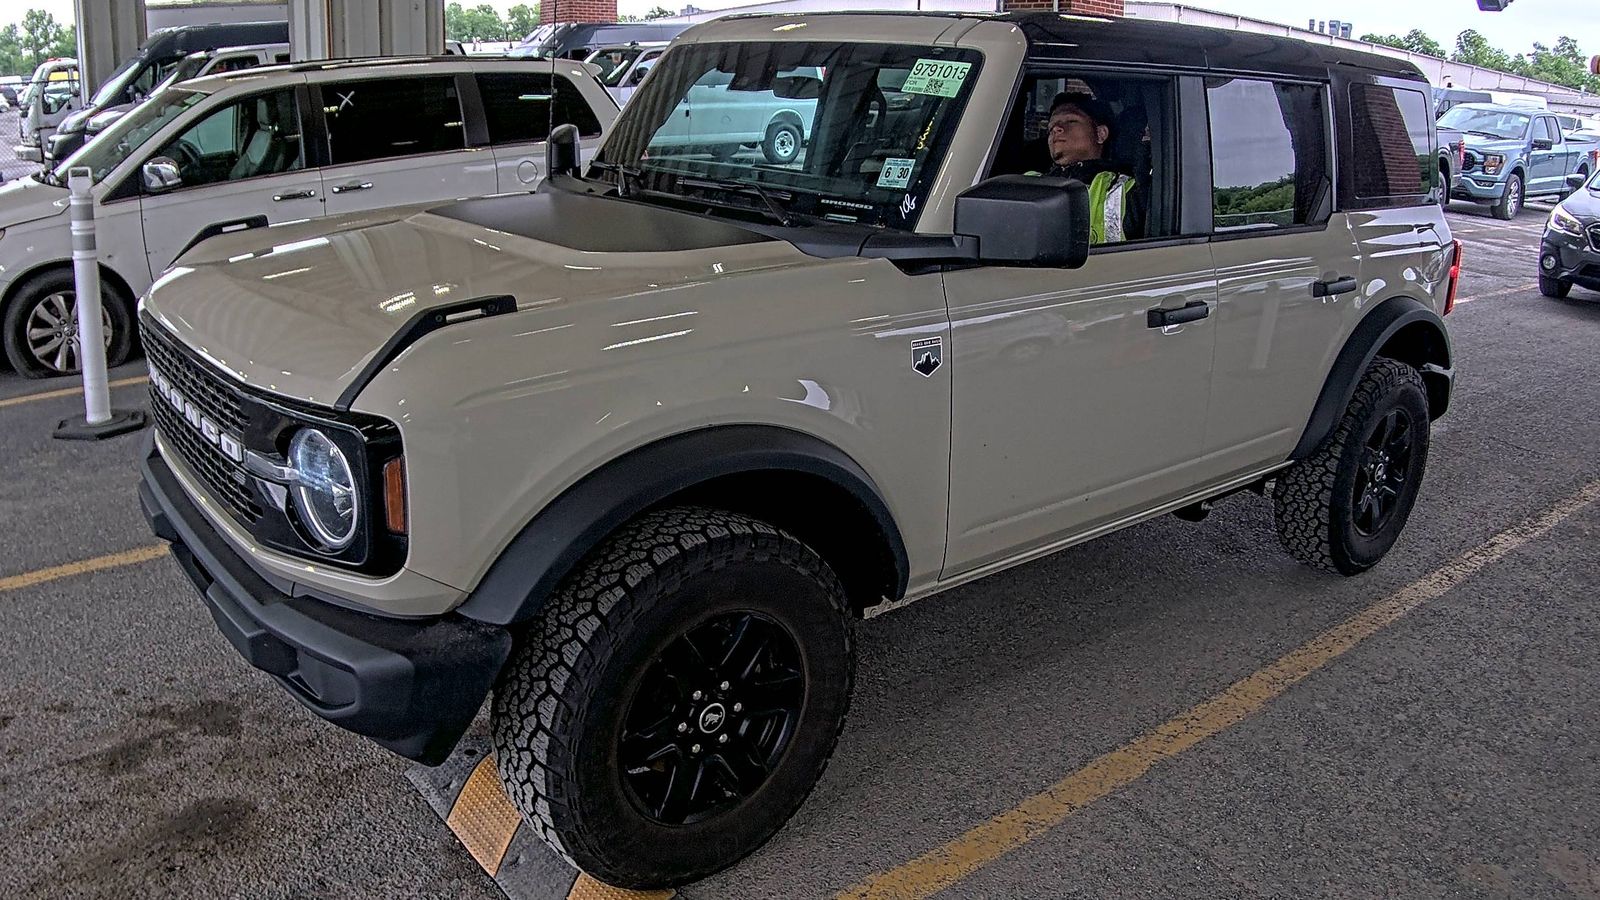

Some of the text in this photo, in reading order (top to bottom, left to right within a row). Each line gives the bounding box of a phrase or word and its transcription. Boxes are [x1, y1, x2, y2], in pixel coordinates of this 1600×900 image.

[913, 63, 968, 80] 9791015
[885, 167, 909, 179] 6 30
